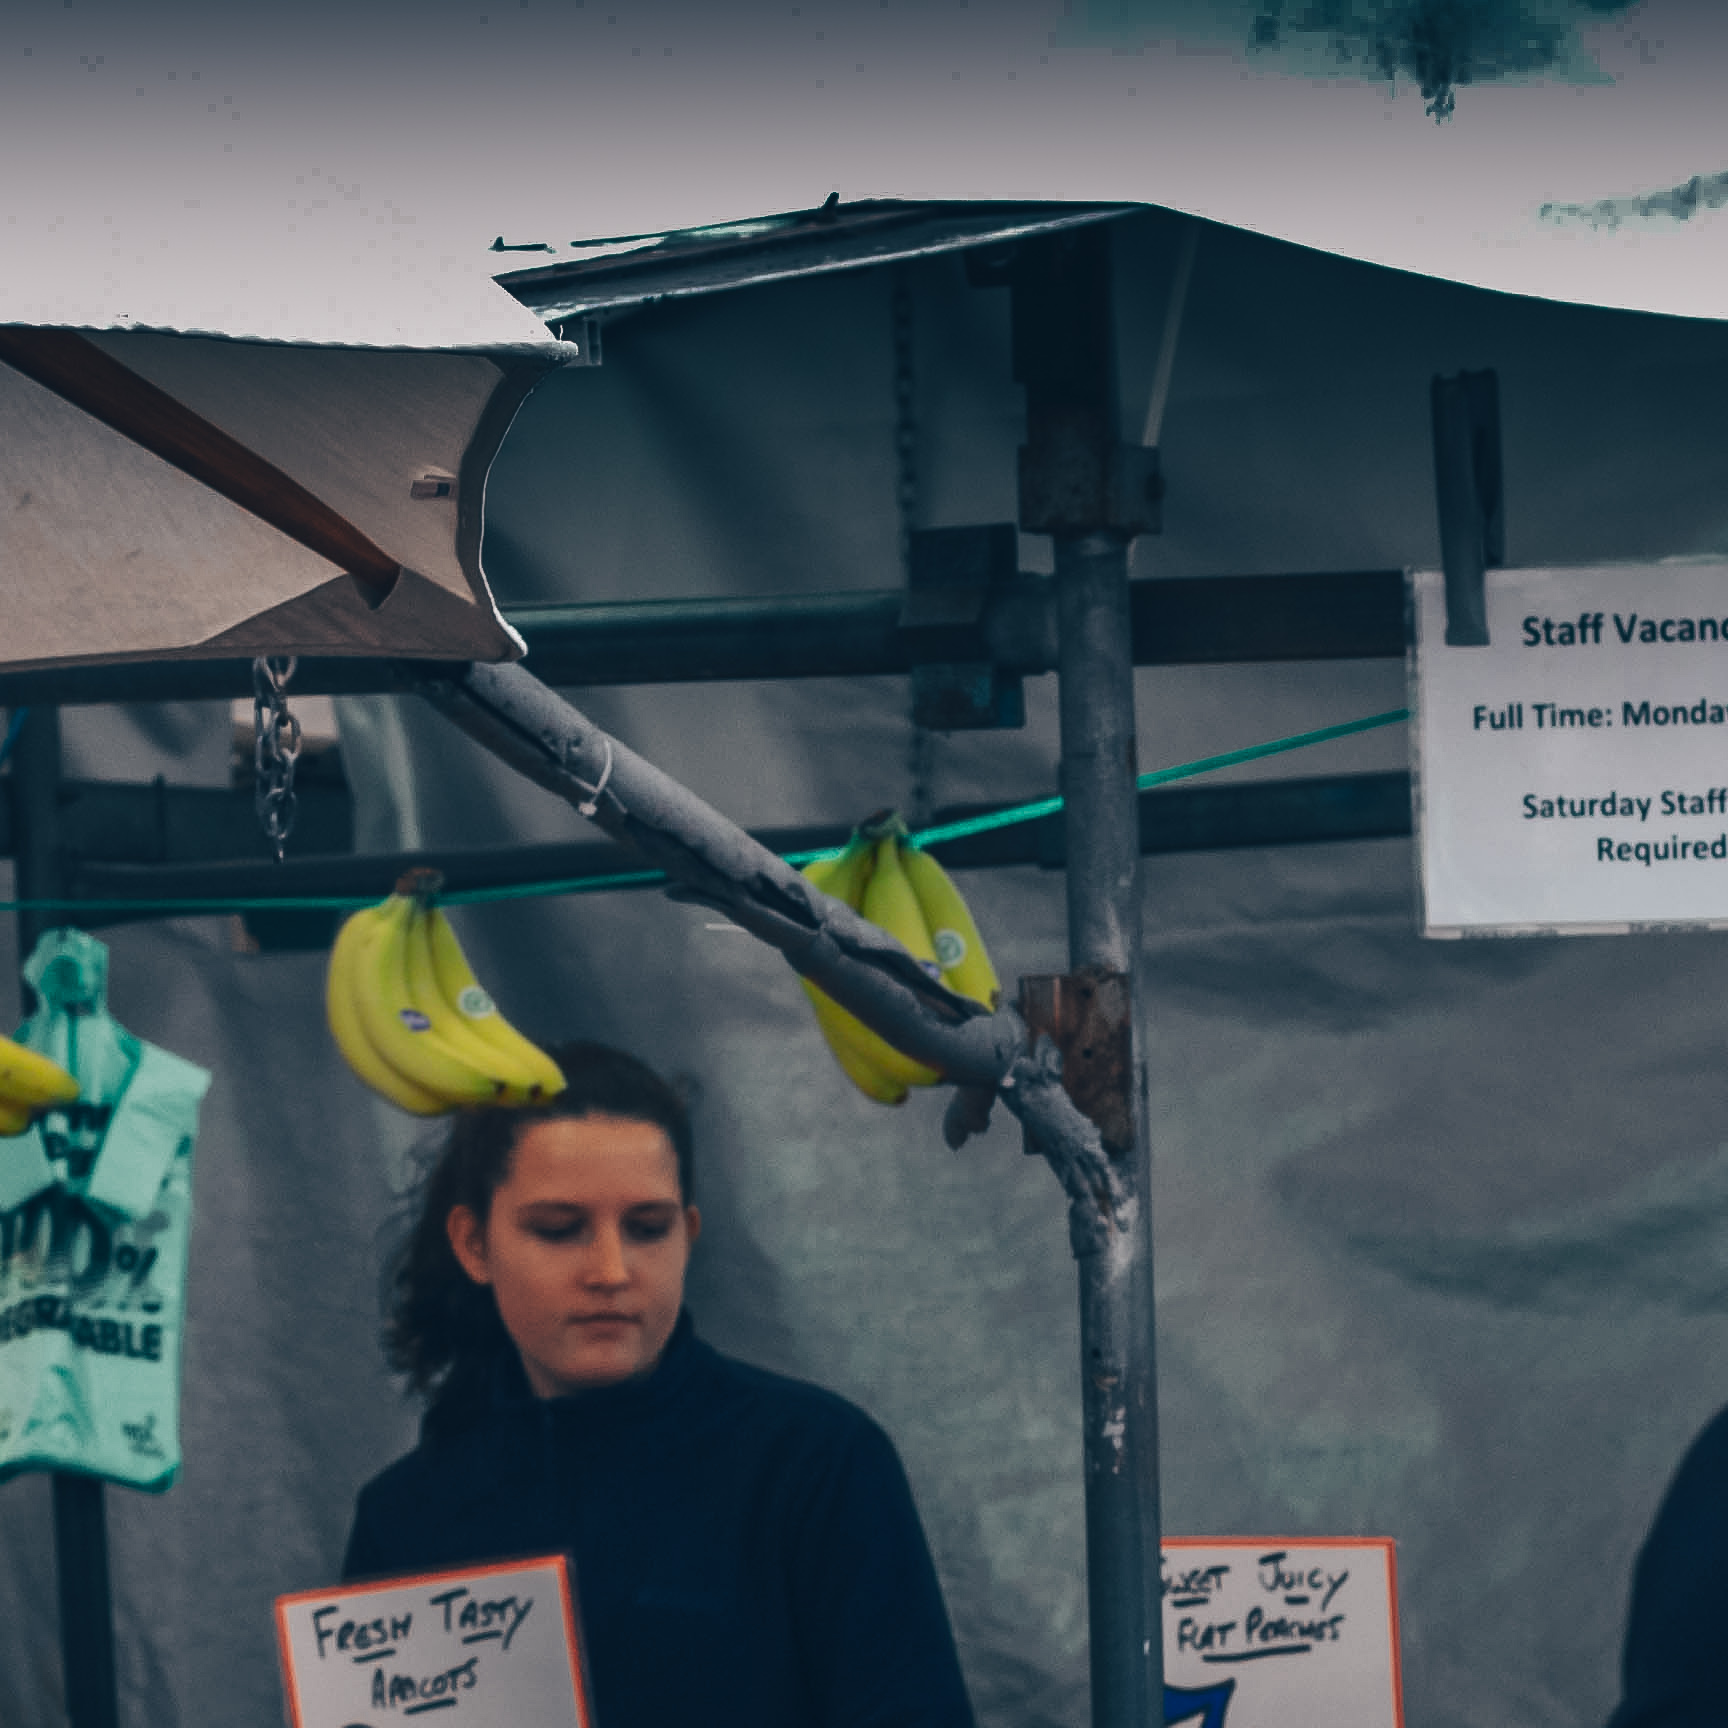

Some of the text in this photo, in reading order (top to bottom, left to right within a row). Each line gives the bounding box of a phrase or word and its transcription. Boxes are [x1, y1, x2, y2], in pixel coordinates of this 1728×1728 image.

[1522, 611, 1605, 647] Staff
[1472, 702, 1524, 730] Full
[1532, 701, 1613, 729] Time:
[1522, 790, 1651, 822] Saturday
[1660, 787, 1728, 817] Staff
[1596, 833, 1728, 867] Required
[1258, 1551, 1349, 1611] JUICY
[312, 1586, 535, 1660] FRESH TASTY
